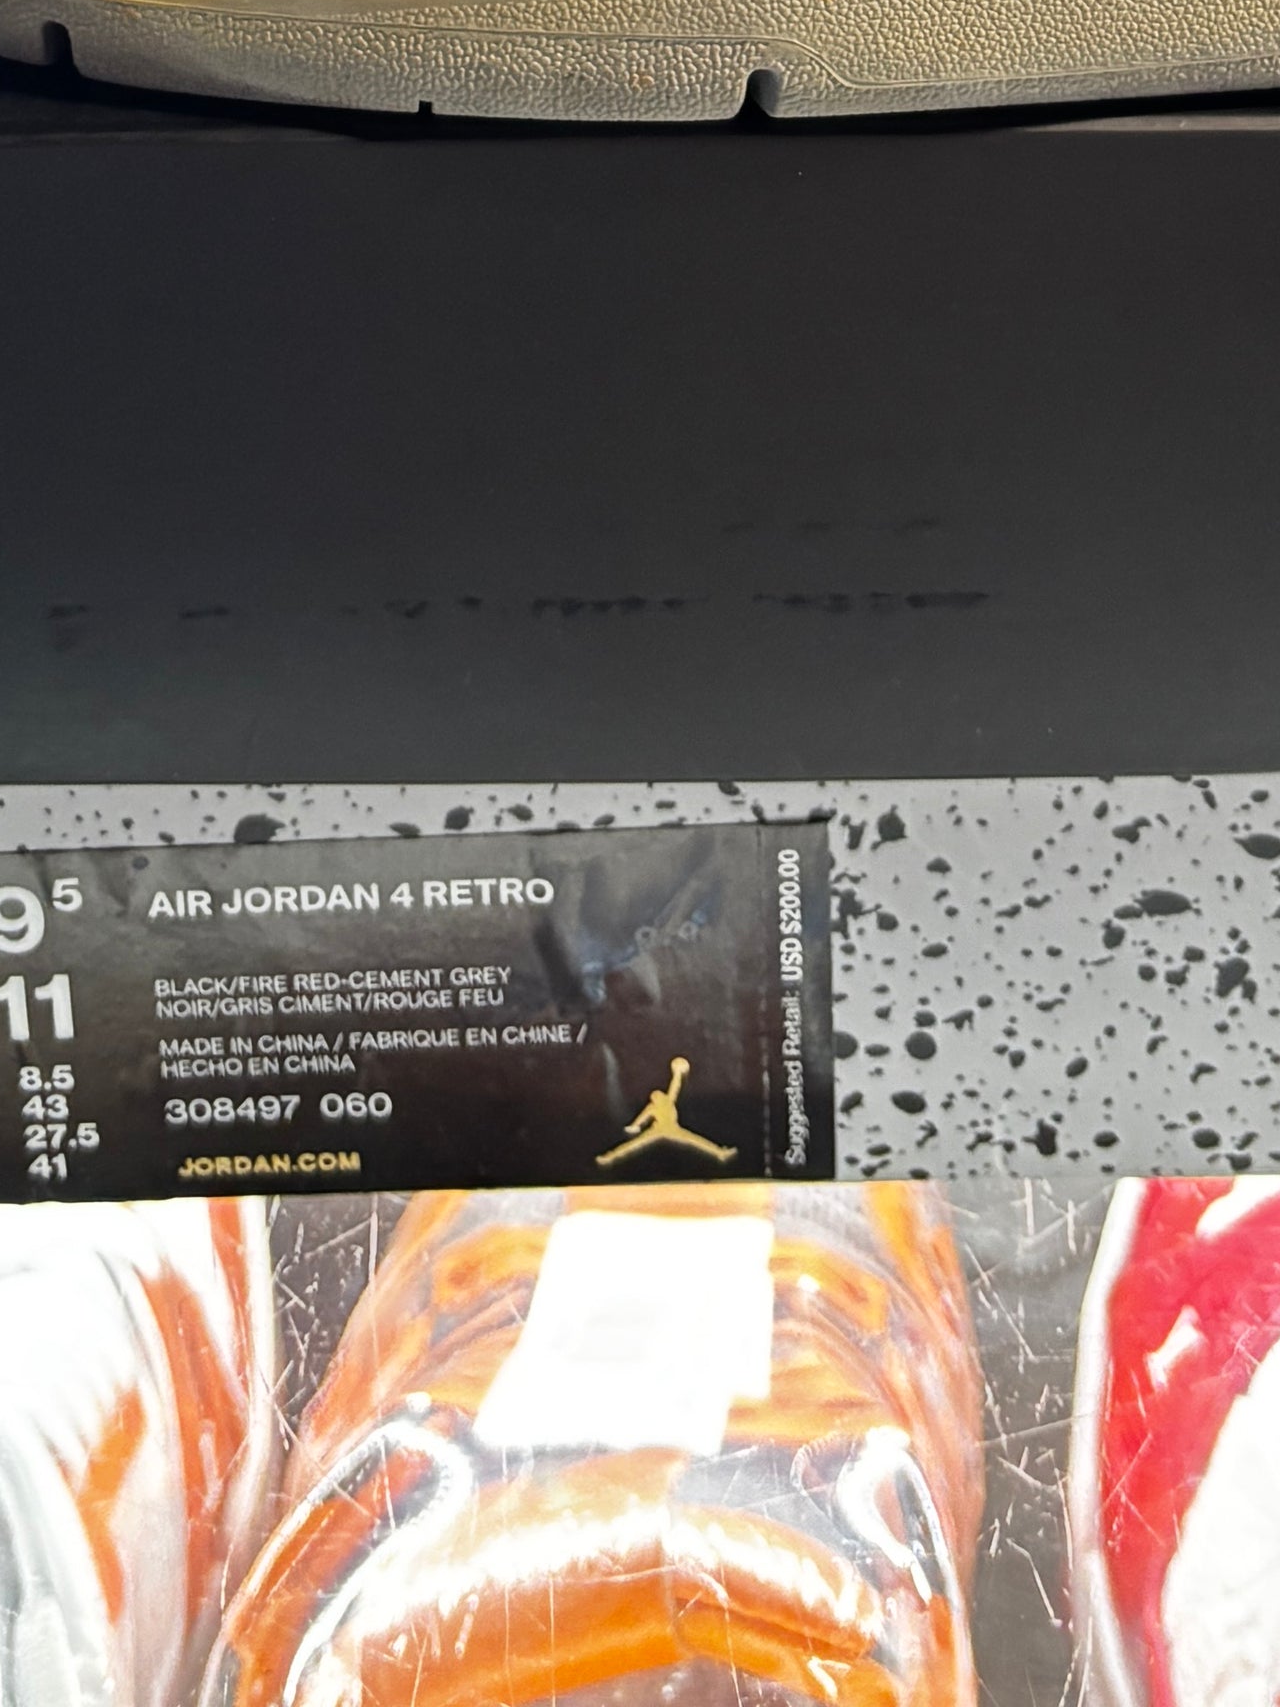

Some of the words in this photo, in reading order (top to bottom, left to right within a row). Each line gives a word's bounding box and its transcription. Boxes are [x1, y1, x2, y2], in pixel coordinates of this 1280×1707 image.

[148, 890, 213, 918] AIR
[222, 883, 380, 914] JORDAN
[390, 882, 414, 908] 4
[423, 877, 554, 907] RETRO
[780, 937, 803, 981] USD
[154, 974, 288, 997] BLACK/FIRE
[293, 968, 443, 992] RED-CEMENT
[450, 966, 511, 987] GREY
[156, 996, 273, 1019] NOIR/GRIS
[278, 989, 452, 1013] CIMENT/ROUGE
[459, 988, 504, 1007] FEU
[159, 1037, 224, 1058] MADE
[230, 1036, 252, 1055] IN
[258, 1033, 329, 1053] CHINA
[349, 1028, 459, 1050] FABRIQUE
[465, 1027, 497, 1046] EN
[502, 1024, 571, 1045] CHINE
[19, 1064, 75, 1090] 8.5
[160, 1057, 242, 1079] HECHO
[248, 1056, 280, 1076] EN
[284, 1053, 356, 1073] CHINA
[22, 1094, 69, 1120] 43
[164, 1094, 301, 1124] 308497
[320, 1091, 393, 1119] 060
[784, 1059, 809, 1165] Suggested
[24, 1122, 100, 1150] 27.5
[28, 1153, 68, 1179] 41
[178, 1151, 361, 1178] JORDAN.COM
